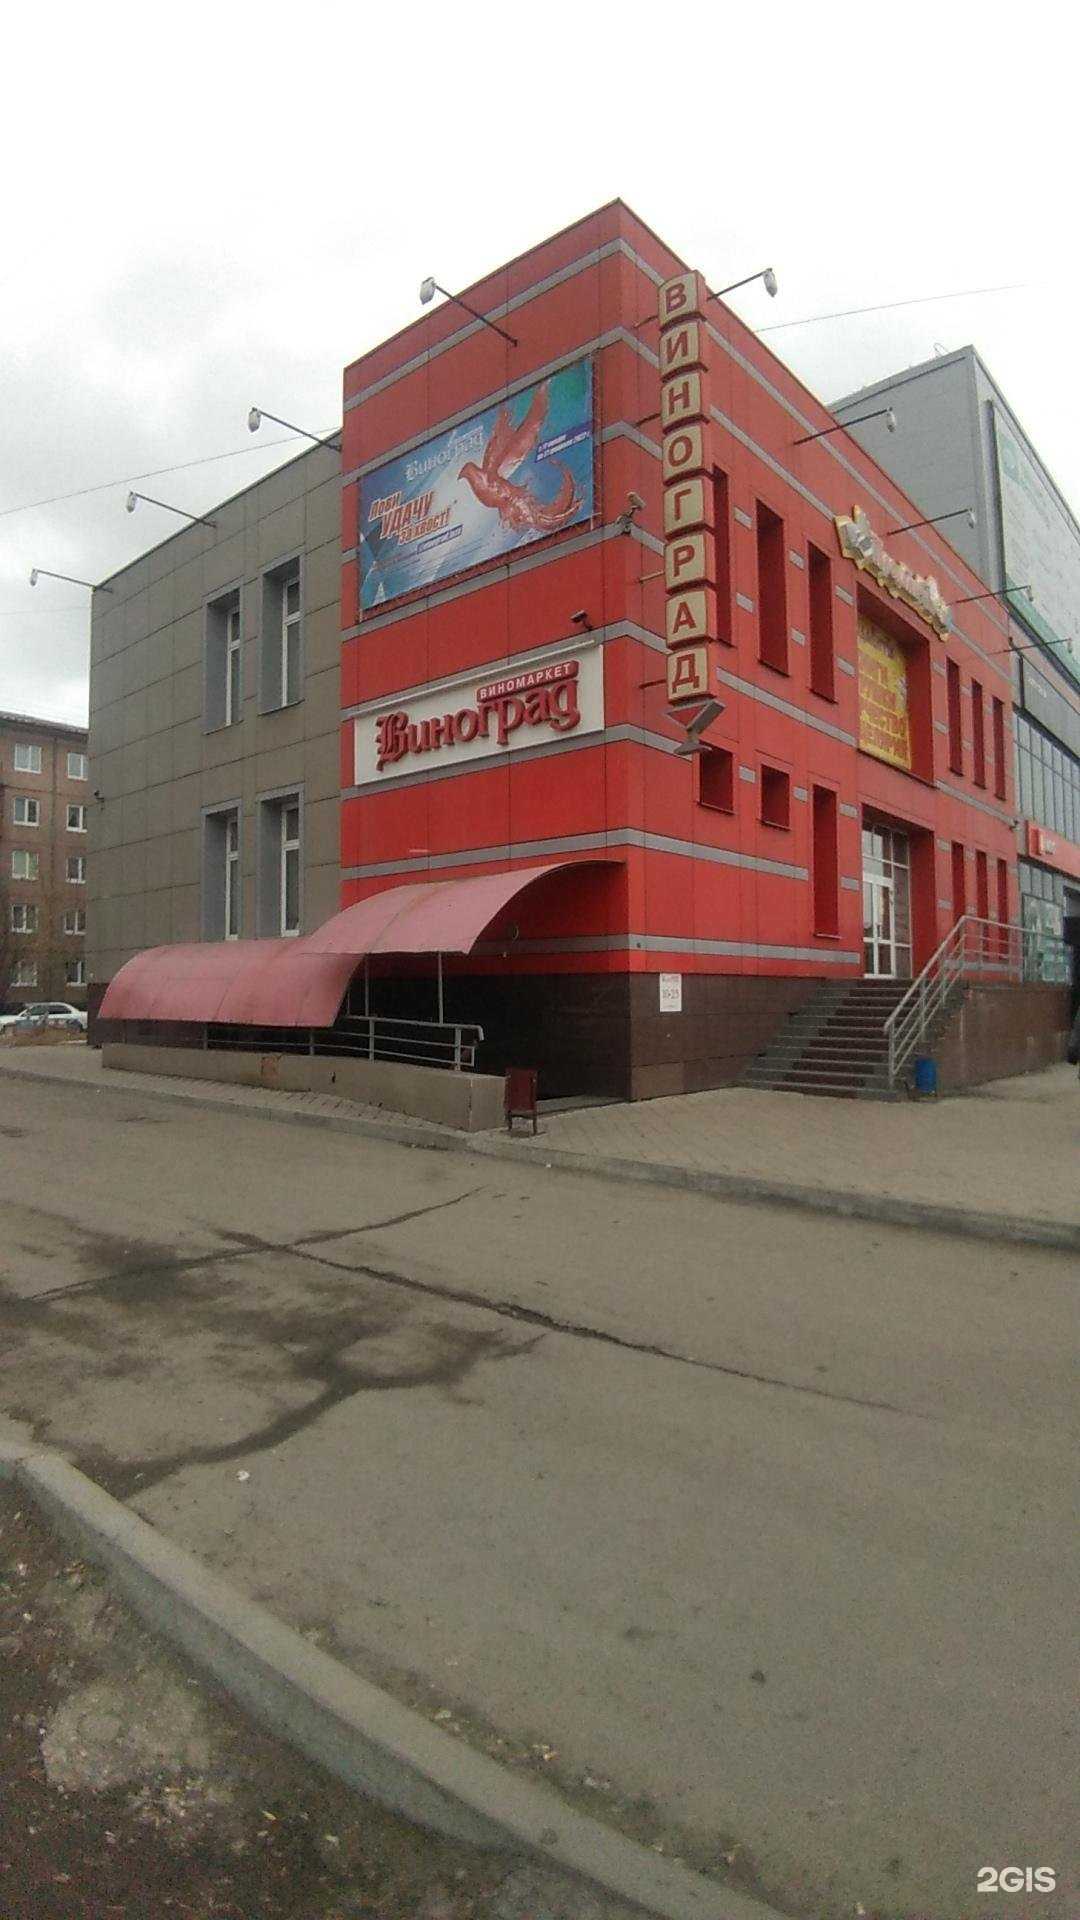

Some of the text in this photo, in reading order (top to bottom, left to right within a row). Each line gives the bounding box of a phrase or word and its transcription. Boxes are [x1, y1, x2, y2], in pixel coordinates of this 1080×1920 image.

[664, 282, 700, 694] ВИНОГРАД
[375, 680, 581, 772] Виноград
[479, 663, 572, 699] ВИНОМАРКЕТ
